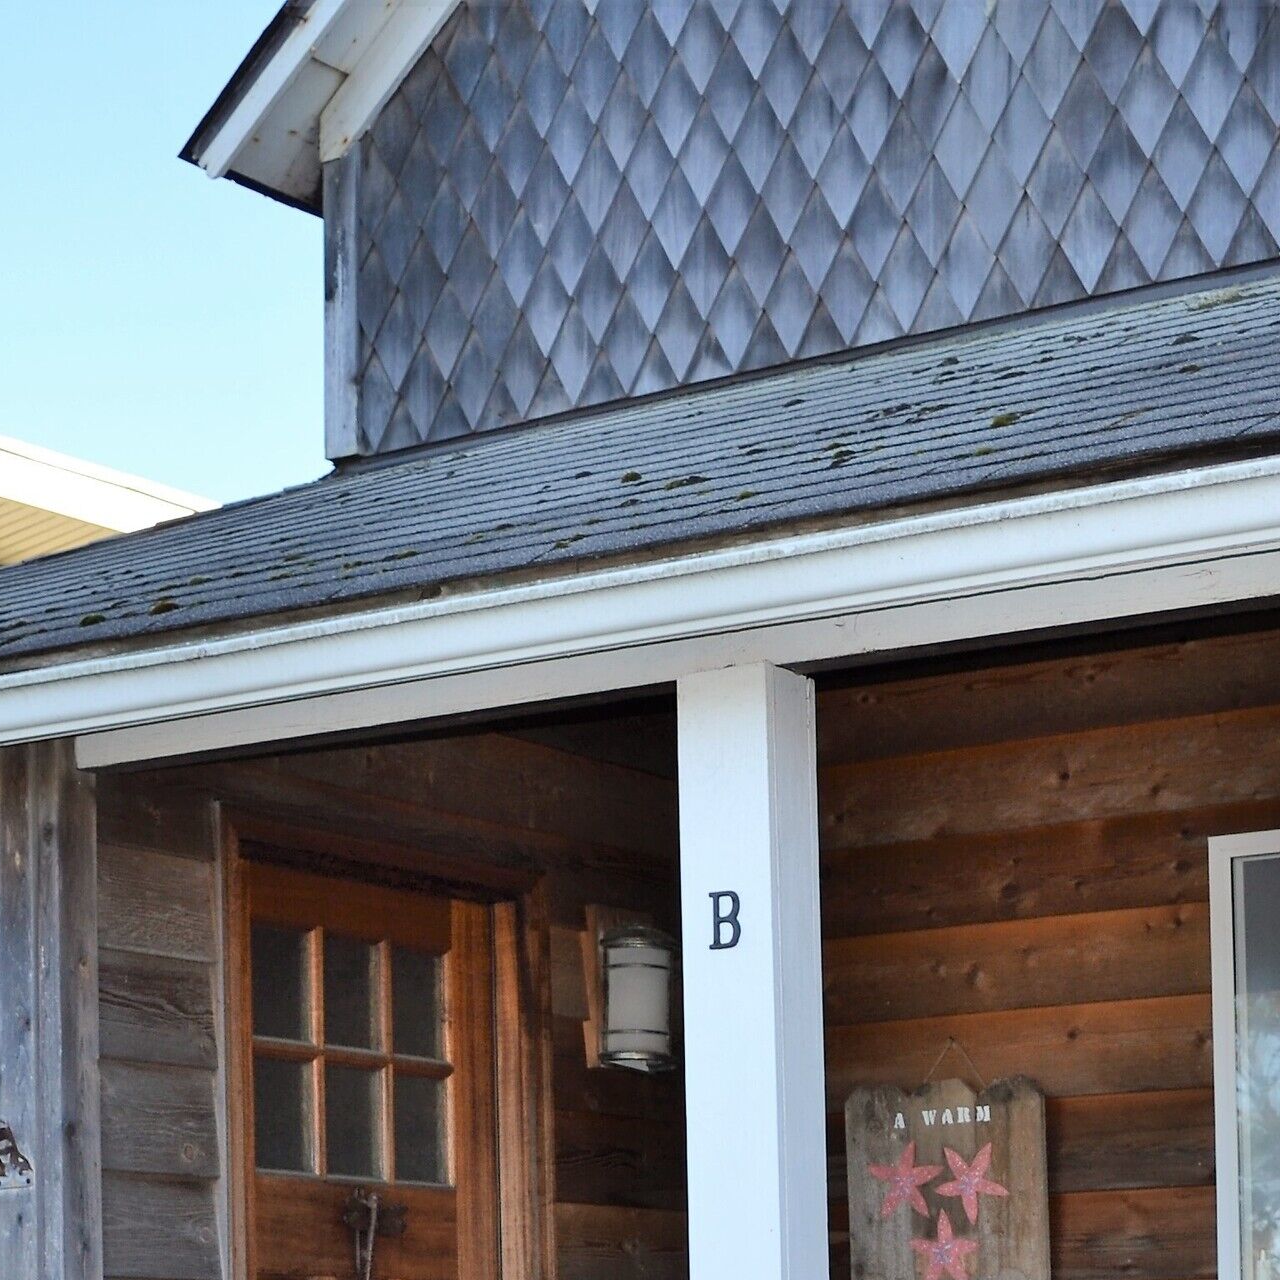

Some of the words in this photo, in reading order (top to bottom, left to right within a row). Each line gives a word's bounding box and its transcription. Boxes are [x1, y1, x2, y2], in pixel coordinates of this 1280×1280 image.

[708, 890, 742, 950] B
[893, 1112, 906, 1129] A
[921, 1105, 991, 1126] WARM
